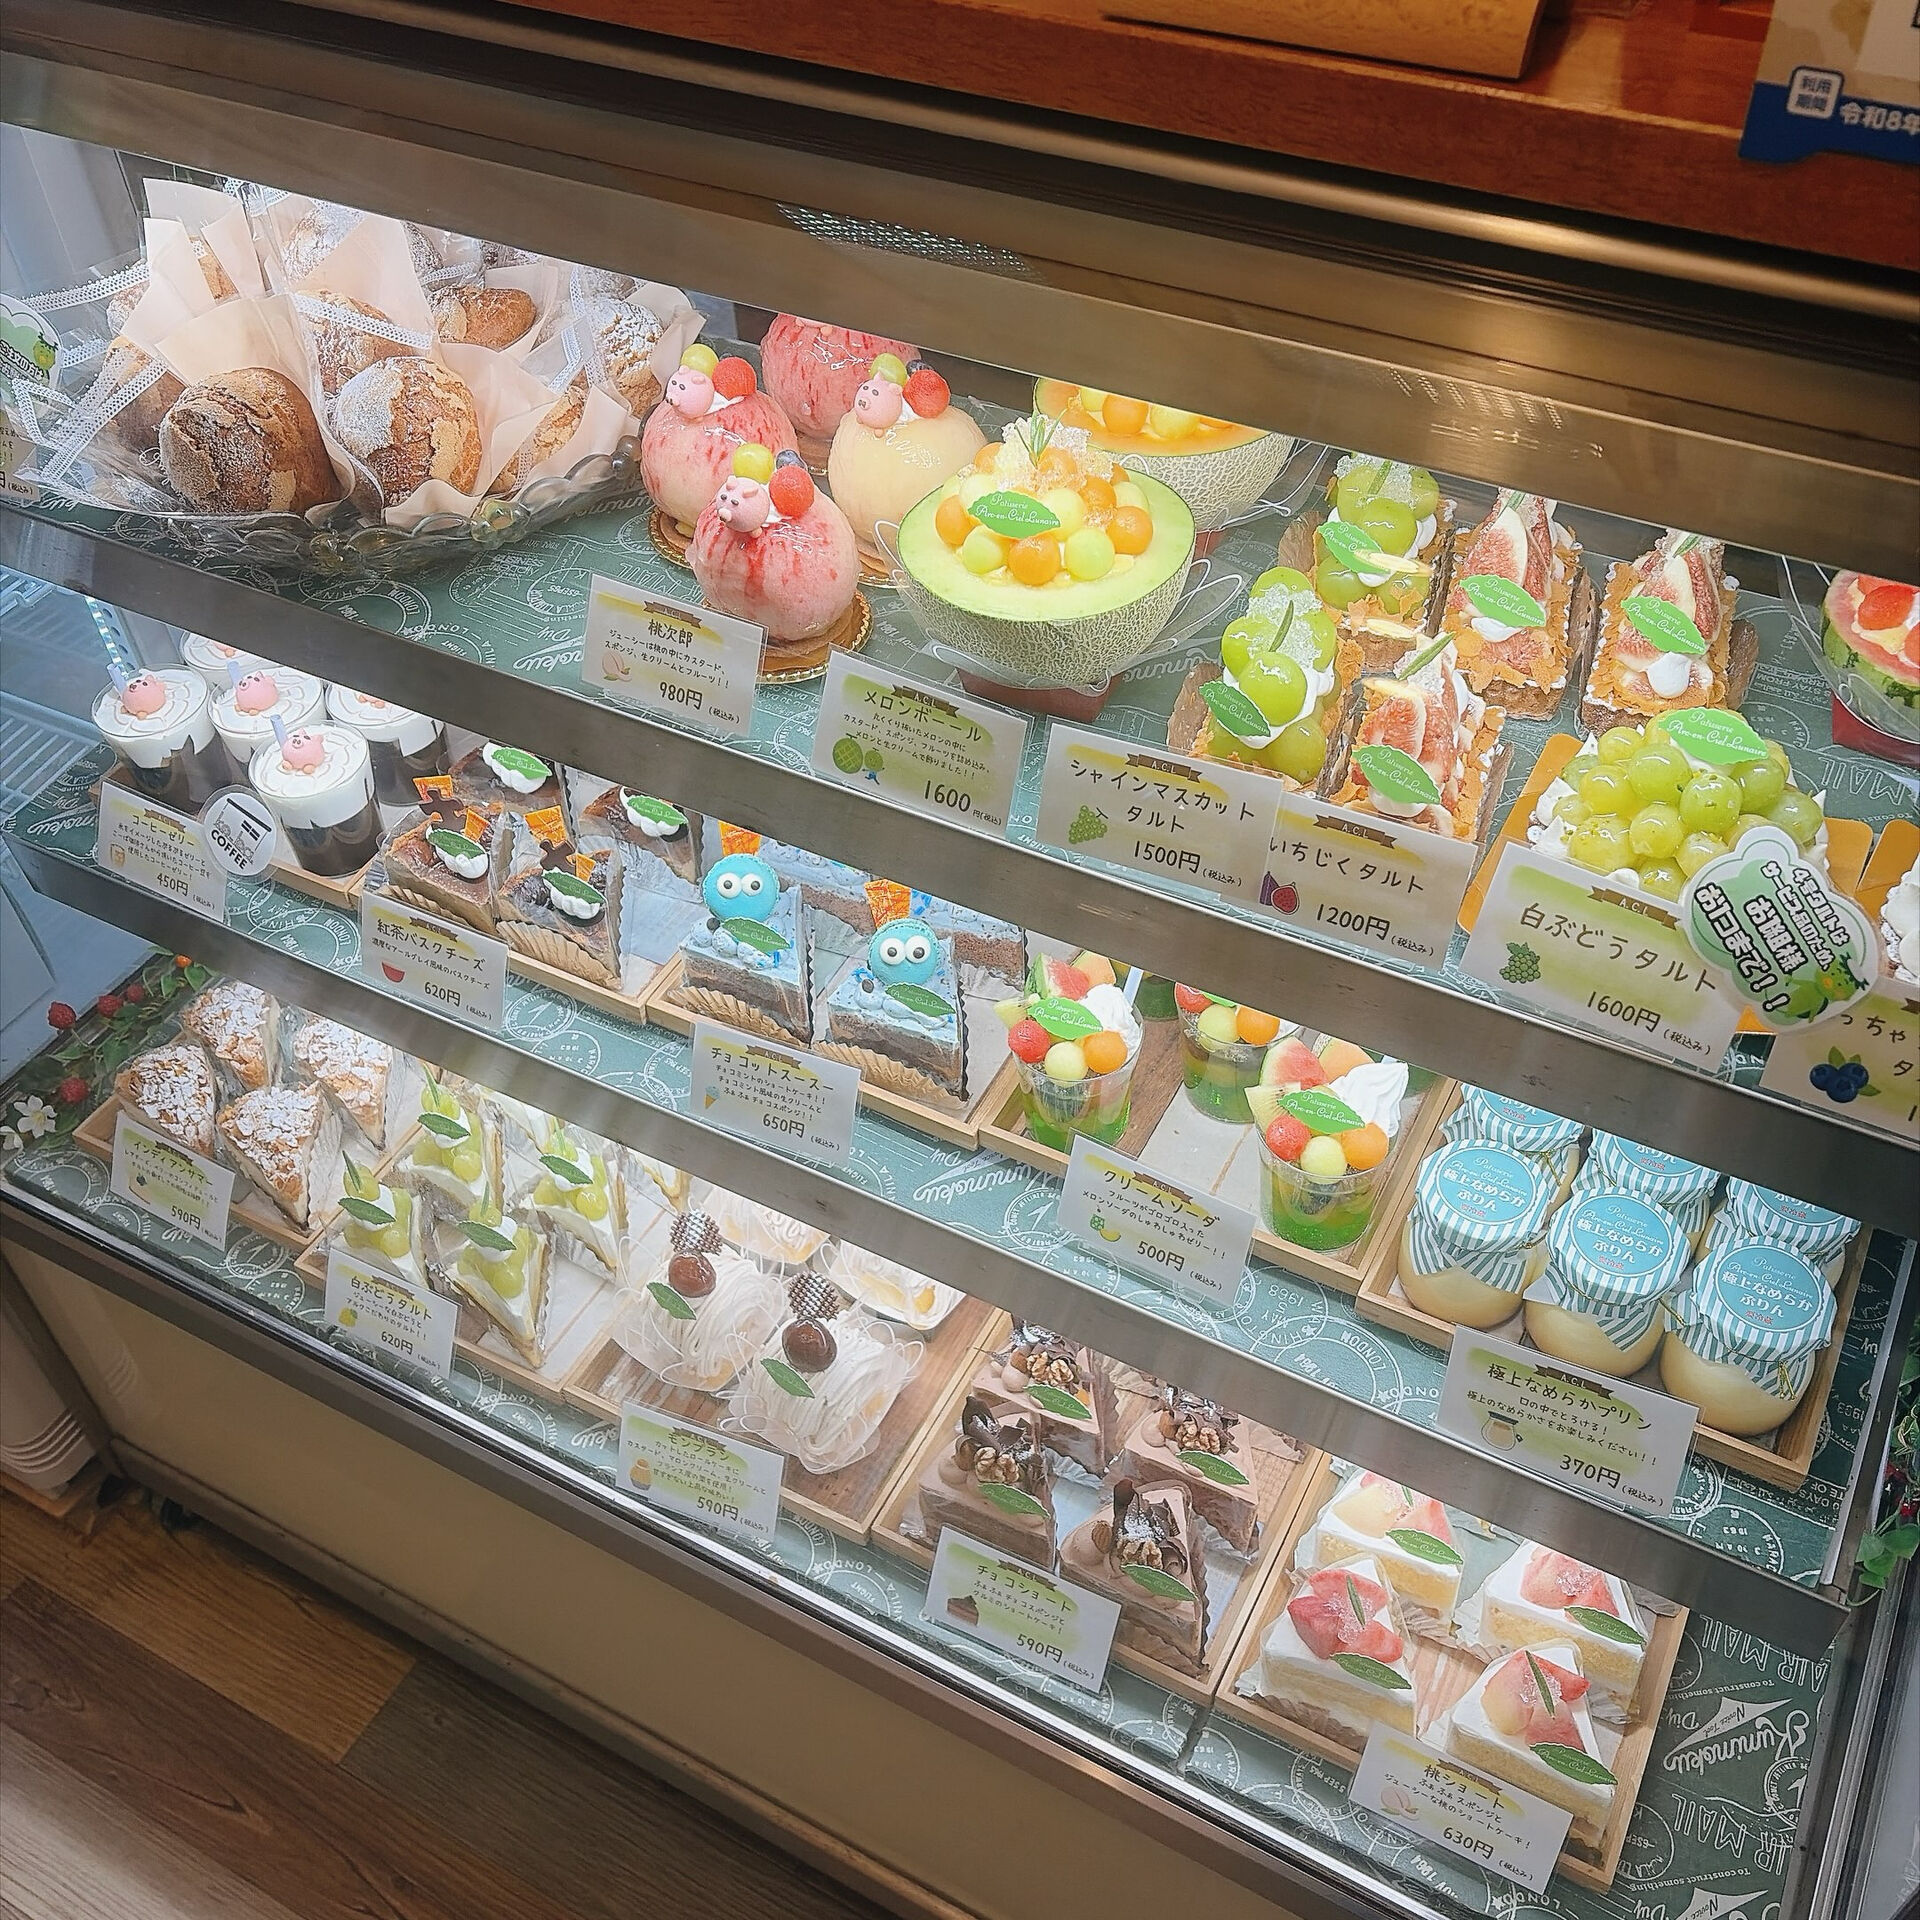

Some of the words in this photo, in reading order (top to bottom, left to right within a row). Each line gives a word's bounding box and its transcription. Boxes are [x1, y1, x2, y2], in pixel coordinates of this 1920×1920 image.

[1839, 102, 1920, 135] 令和8年
[648, 619, 693, 648] 桃次郎
[659, 681, 703, 710] 980円
[708, 706, 740, 723] (税込み)
[1151, 760, 1176, 774] A.C.L
[925, 780, 971, 812] 1600
[1071, 759, 1255, 821] シャインマスカット
[132, 815, 194, 847] コーヒーゼリー
[1127, 805, 1185, 832] タルト
[1341, 823, 1369, 838] A.C.L
[211, 829, 248, 870] COFFEE
[1134, 840, 1200, 873] 1500円
[1202, 868, 1242, 886] (税込み)
[1270, 837, 1424, 894] いちじくタルト
[157, 873, 189, 897] 450円
[1619, 897, 1649, 915] A.C.L
[1791, 867, 1850, 947] 4号タルトは
[377, 918, 486, 972] 紅茶バスクチーズ
[1316, 903, 1390, 940] 1200円
[1391, 935, 1434, 957] (税込み)
[1521, 903, 1716, 993] 白ぶどうタルト
[424, 982, 461, 1007] 620円
[1587, 991, 1661, 1032] 1600円
[1663, 1028, 1711, 1055] (税込み)
[711, 1047, 834, 1092] チョコットスースー
[762, 1113, 805, 1139] 650円
[134, 1141, 213, 1186] インディアンサマー
[1104, 1170, 1220, 1228] クリームソーダ
[1443, 1167, 1527, 1208] 極上なめらか
[1457, 1189, 1498, 1213] ぷりん
[170, 1205, 201, 1230] 590円
[1108, 1190, 1205, 1239] フルーツがゴロゴロ入った
[1138, 1241, 1185, 1272] 500円
[1576, 1217, 1664, 1258] 極上なめらか
[1592, 1240, 1636, 1264] ぷりん
[351, 1275, 432, 1320] 白ぶどうタルト
[1721, 1270, 1815, 1311] 極上なめらか
[1740, 1292, 1784, 1318] ぷりん
[381, 1331, 413, 1355] 620円
[1340, 1331, 1386, 1372] LONDON
[1487, 1363, 1652, 1430] 極上なめらかプリン
[1519, 1396, 1608, 1436] 口の中でとろける！
[668, 1432, 730, 1461] モンブラン
[1467, 1390, 1657, 1466] 極上のなめらかさをお楽しみください！！
[1559, 1454, 1621, 1489] 370円
[1622, 1484, 1664, 1507] (税込み)
[696, 1496, 738, 1522] 590円
[977, 1565, 1072, 1613] チョコショート
[1016, 1633, 1063, 1663] 590円
[1700, 1614, 1771, 1672] MAIL
[1714, 1681, 1761, 1694] construct
[1667, 1707, 1700, 1730] Diy
[1663, 1709, 1810, 1776] Kumimoku
[1424, 1764, 1505, 1810] 桃ショート
[1443, 1827, 1494, 1860] 630円
[1671, 1793, 1747, 1859] MAIL
[1686, 1871, 1737, 1884] construct
